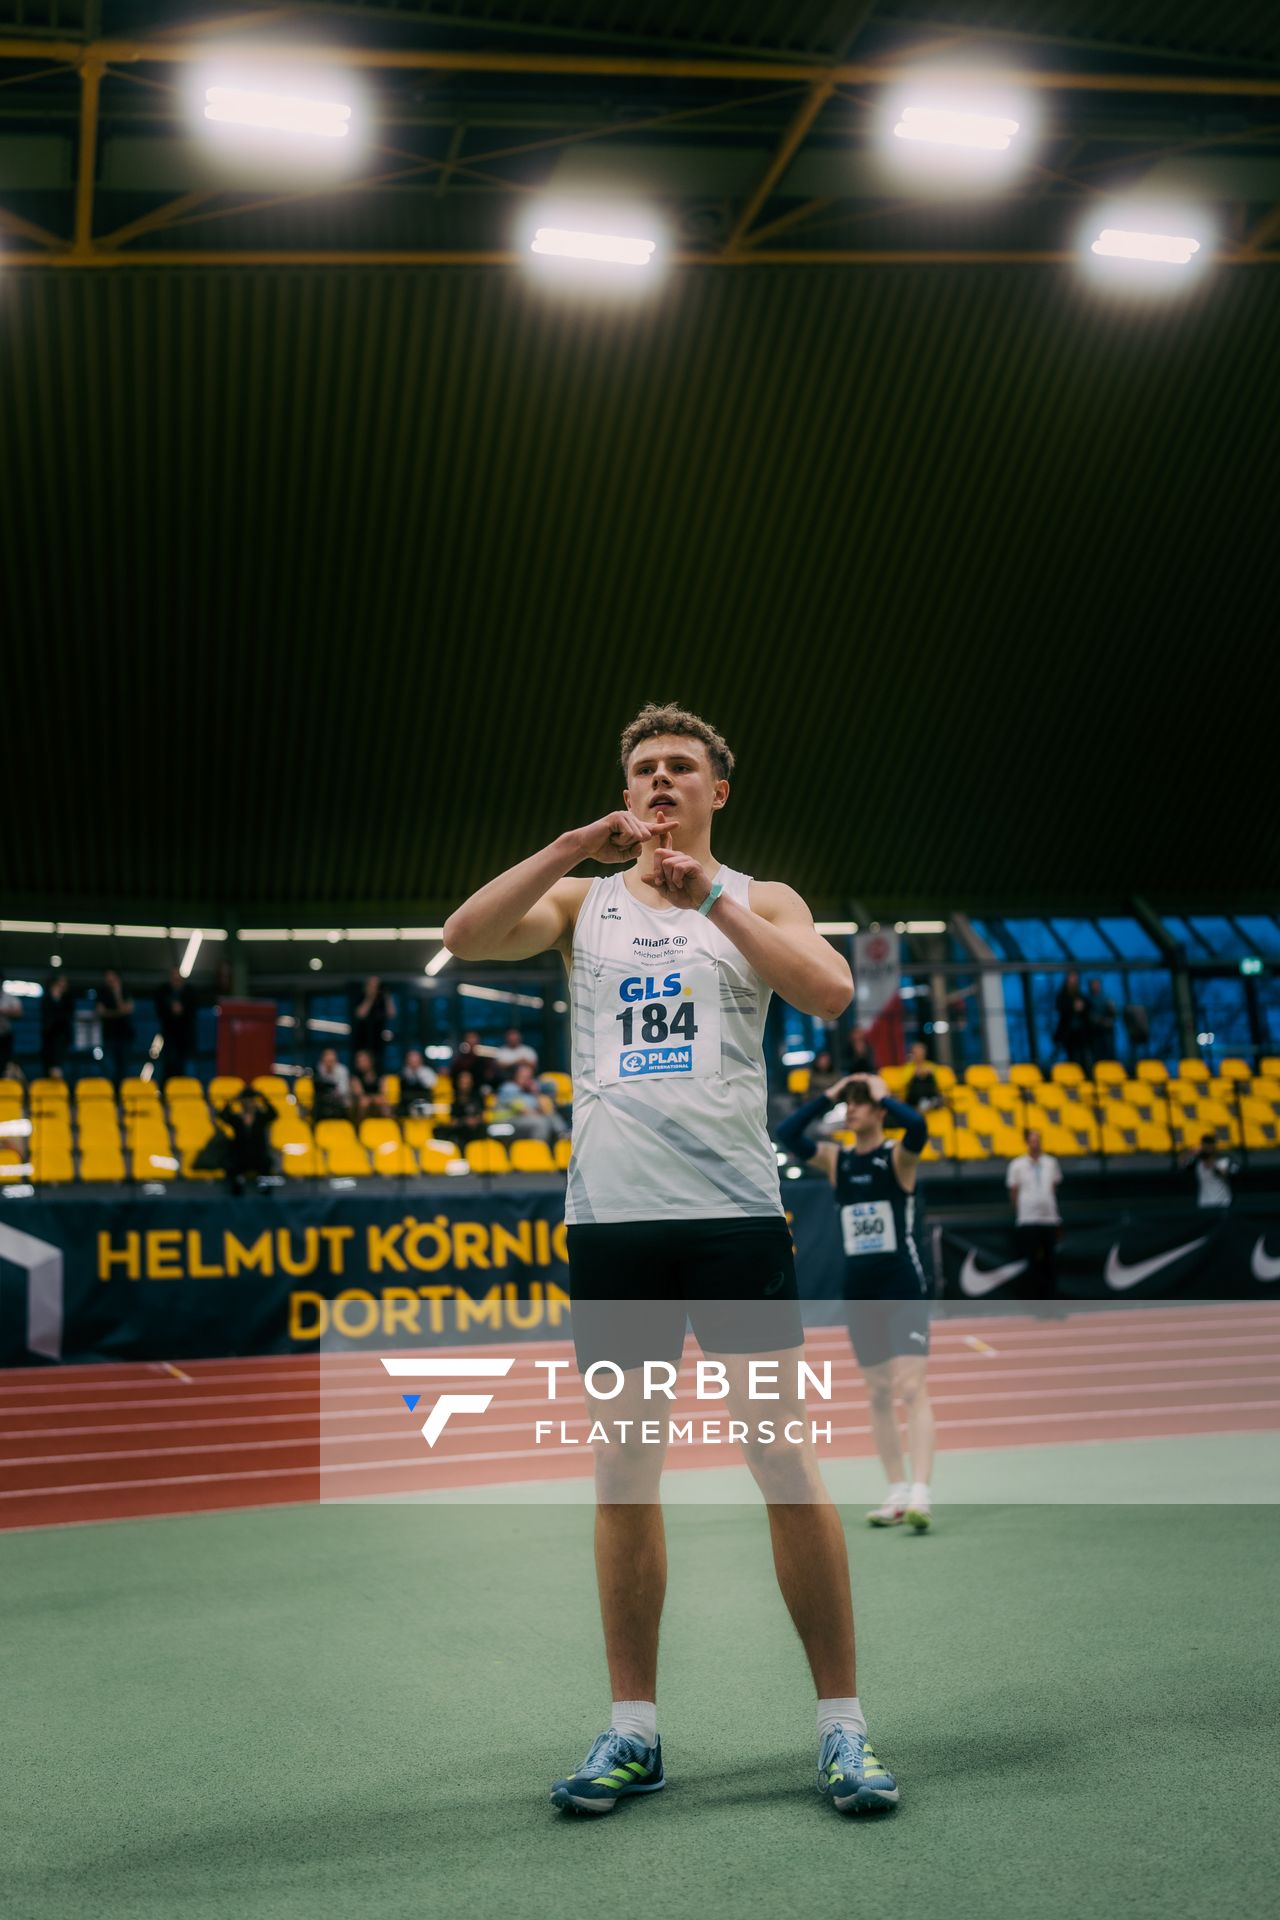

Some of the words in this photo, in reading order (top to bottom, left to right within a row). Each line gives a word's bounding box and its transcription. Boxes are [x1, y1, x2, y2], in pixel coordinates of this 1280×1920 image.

[632, 937, 670, 947] Allianz
[633, 949, 663, 959] Michael
[663, 949, 684, 957] Mann
[616, 1001, 698, 1046] 184
[648, 1051, 689, 1065] PLAN
[648, 1063, 689, 1071] INTERNATIONAL
[853, 1217, 884, 1236] 360
[97, 1226, 355, 1281] HELMUT
